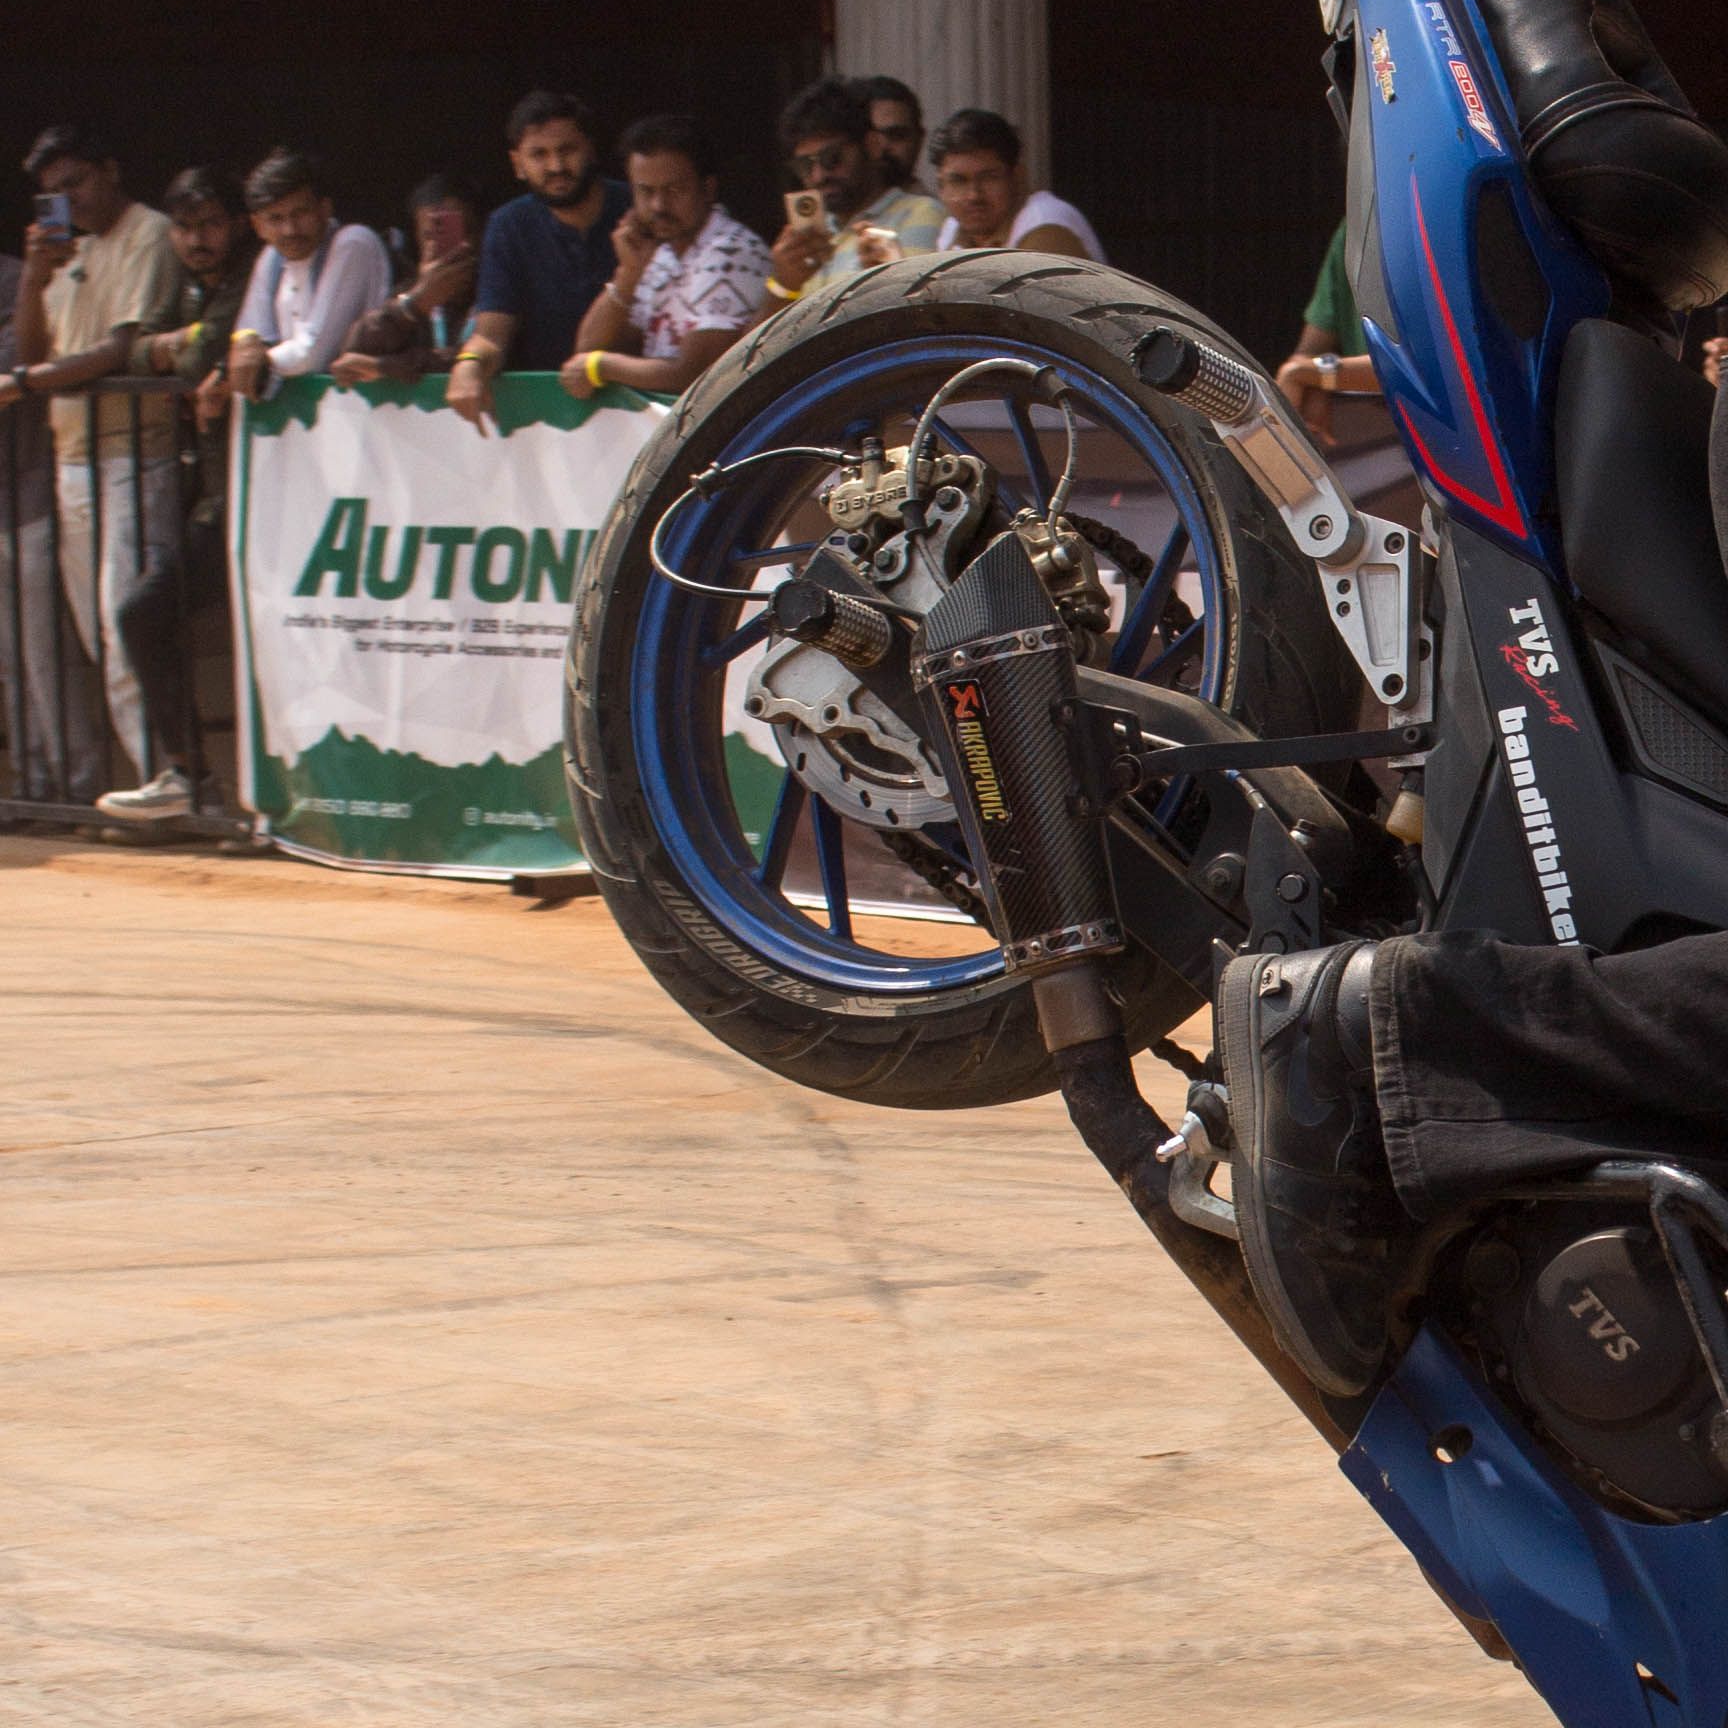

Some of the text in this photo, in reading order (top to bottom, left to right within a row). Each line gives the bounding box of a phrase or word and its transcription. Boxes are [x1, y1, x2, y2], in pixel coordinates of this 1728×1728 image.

[1424, 2, 1462, 56] RTR
[852, 485, 907, 510] BYBRE
[1509, 599, 1559, 678] TVS
[1500, 643, 1579, 732] Racing
[1568, 1287, 1641, 1363] TVS
